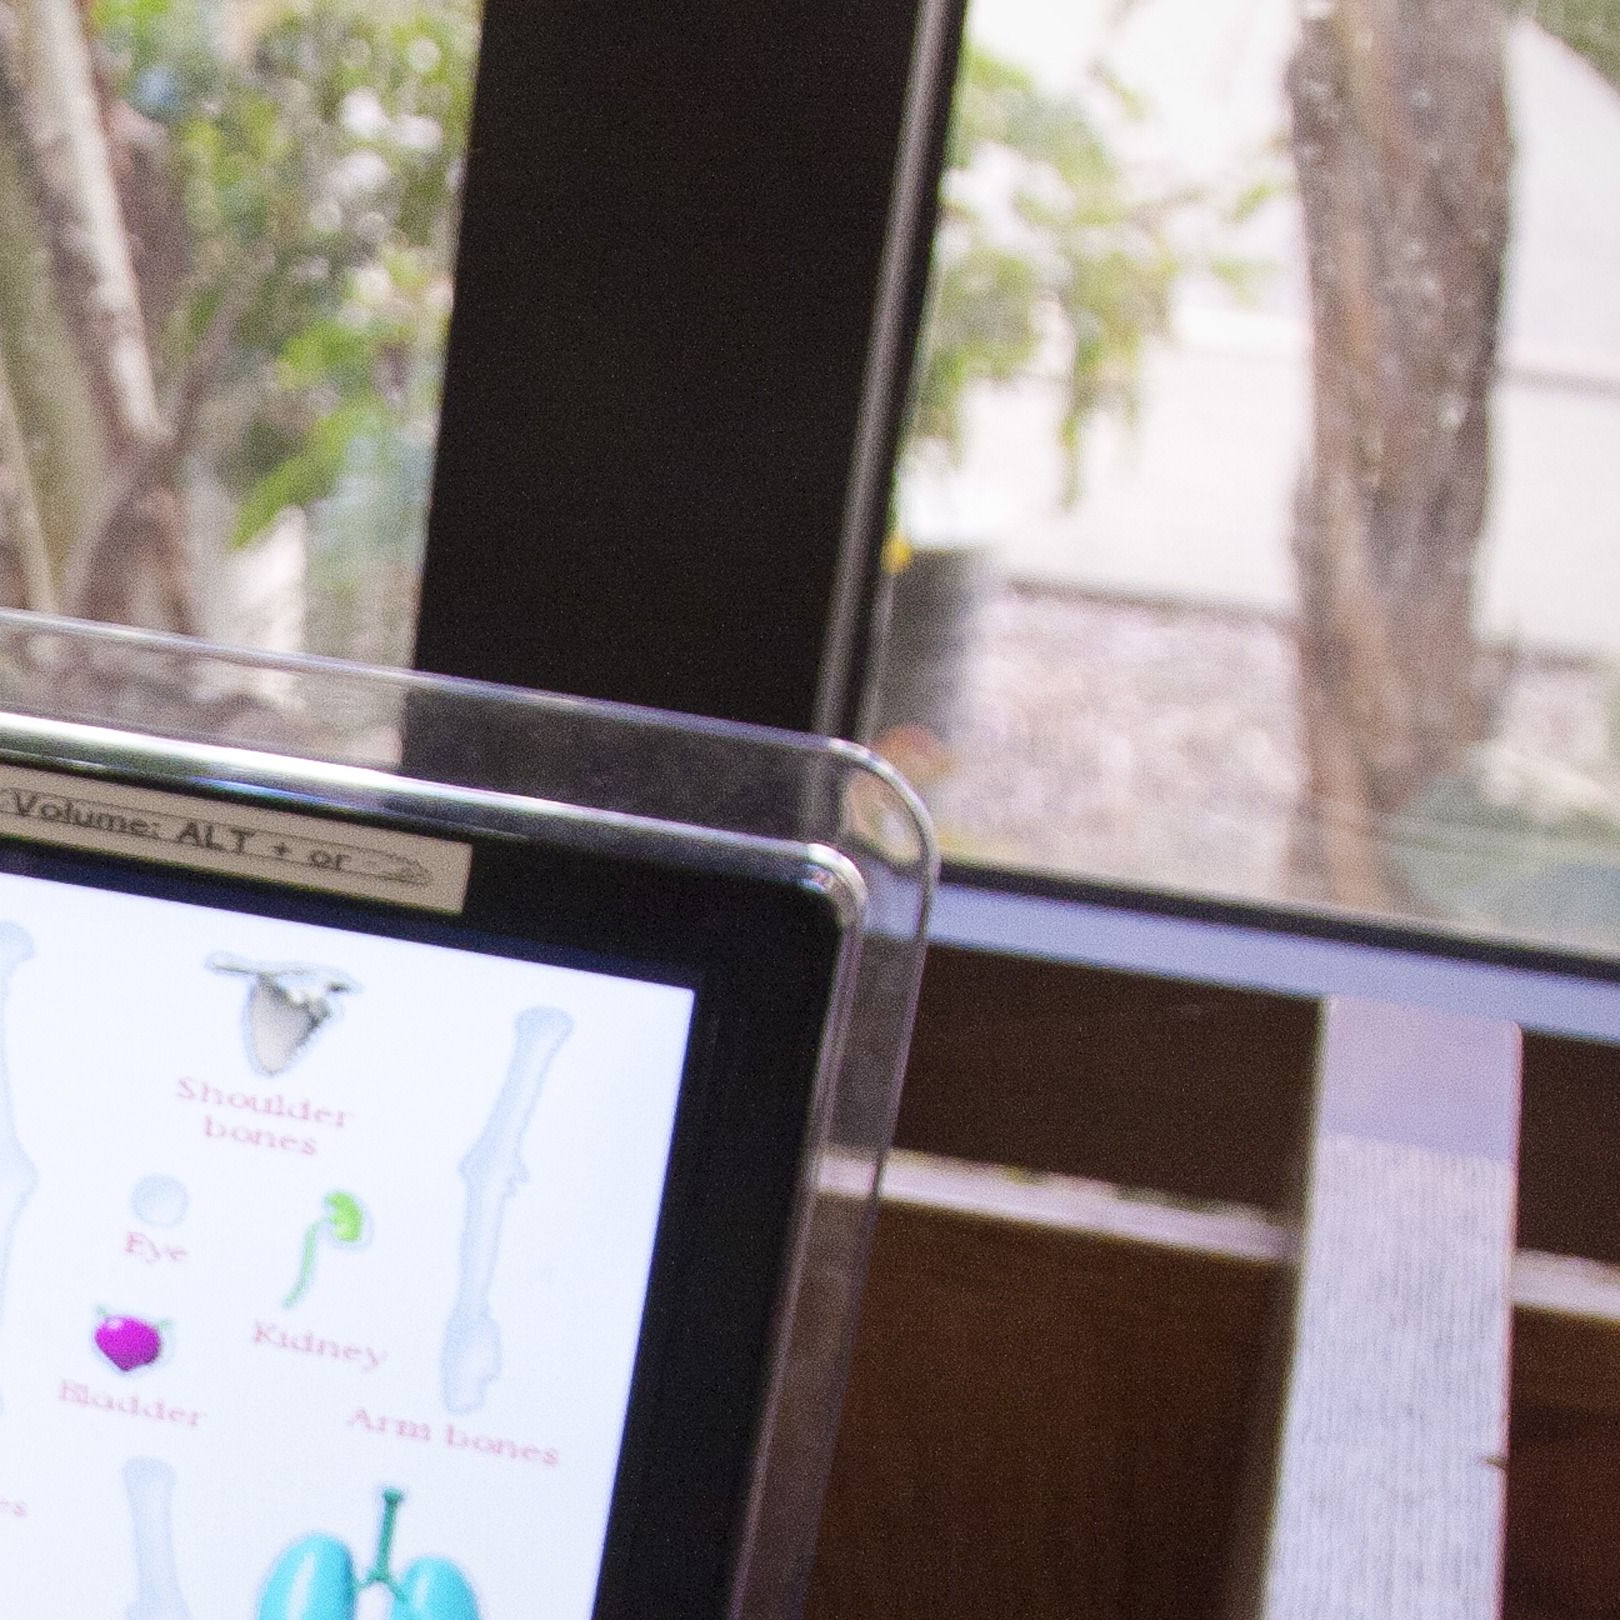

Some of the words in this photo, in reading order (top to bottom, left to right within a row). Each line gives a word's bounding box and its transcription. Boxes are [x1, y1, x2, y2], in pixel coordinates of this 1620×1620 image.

[12, 789, 162, 839] Volume:
[176, 818, 260, 855] ALT
[273, 842, 293, 862] +
[307, 846, 354, 876] or
[176, 1075, 354, 1129] Shoulder
[203, 1114, 319, 1156] bones
[124, 1230, 190, 1264] Eye
[252, 1320, 390, 1372] Kidney
[58, 1377, 208, 1429] Bladder
[347, 1405, 433, 1442] Arm
[442, 1423, 561, 1468] bones
